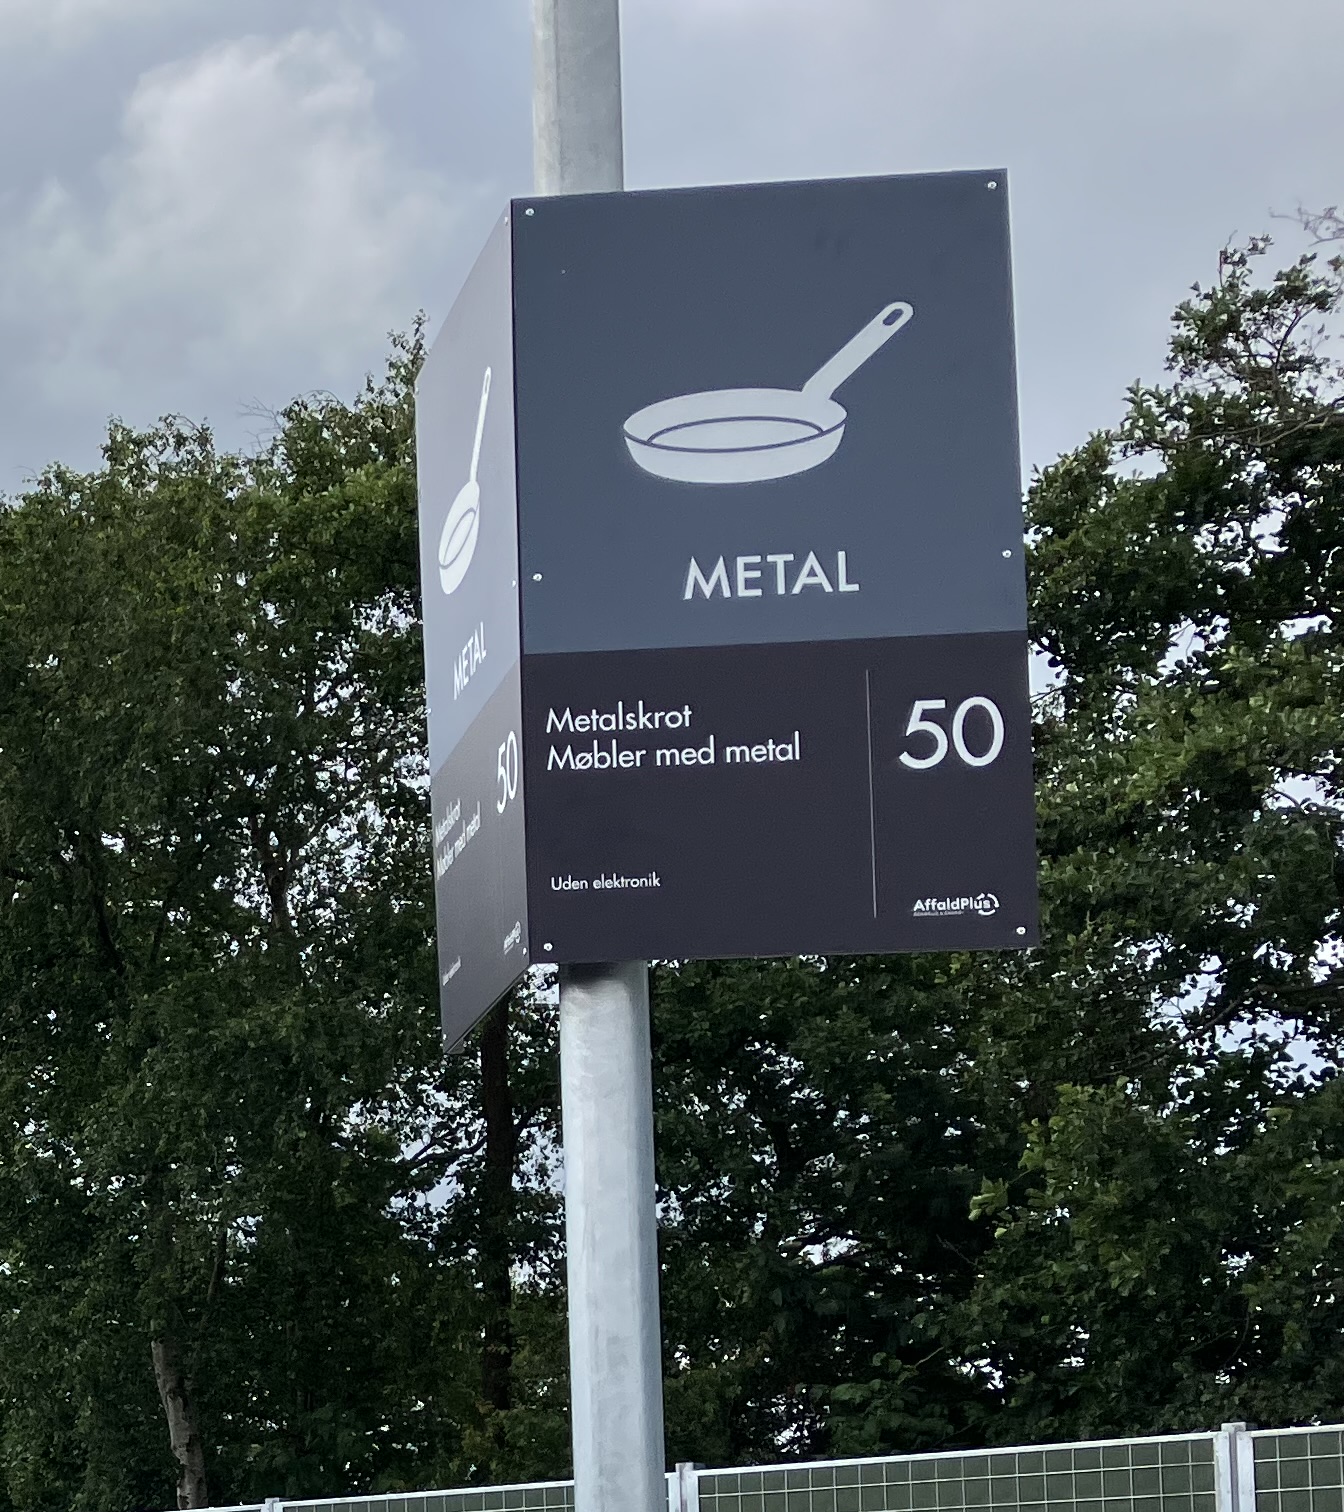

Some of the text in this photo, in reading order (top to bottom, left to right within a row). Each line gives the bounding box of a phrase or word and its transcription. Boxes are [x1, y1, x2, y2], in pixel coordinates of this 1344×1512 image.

[683, 550, 860, 600] METAL
[454, 621, 487, 700] METAL
[546, 700, 692, 734] Metalskrot
[899, 696, 1005, 769] 50
[497, 731, 518, 814] 50
[547, 730, 800, 771] Møbler med metal
[551, 871, 661, 891] Uden elektronik
[913, 895, 993, 912] AffaldPlus
